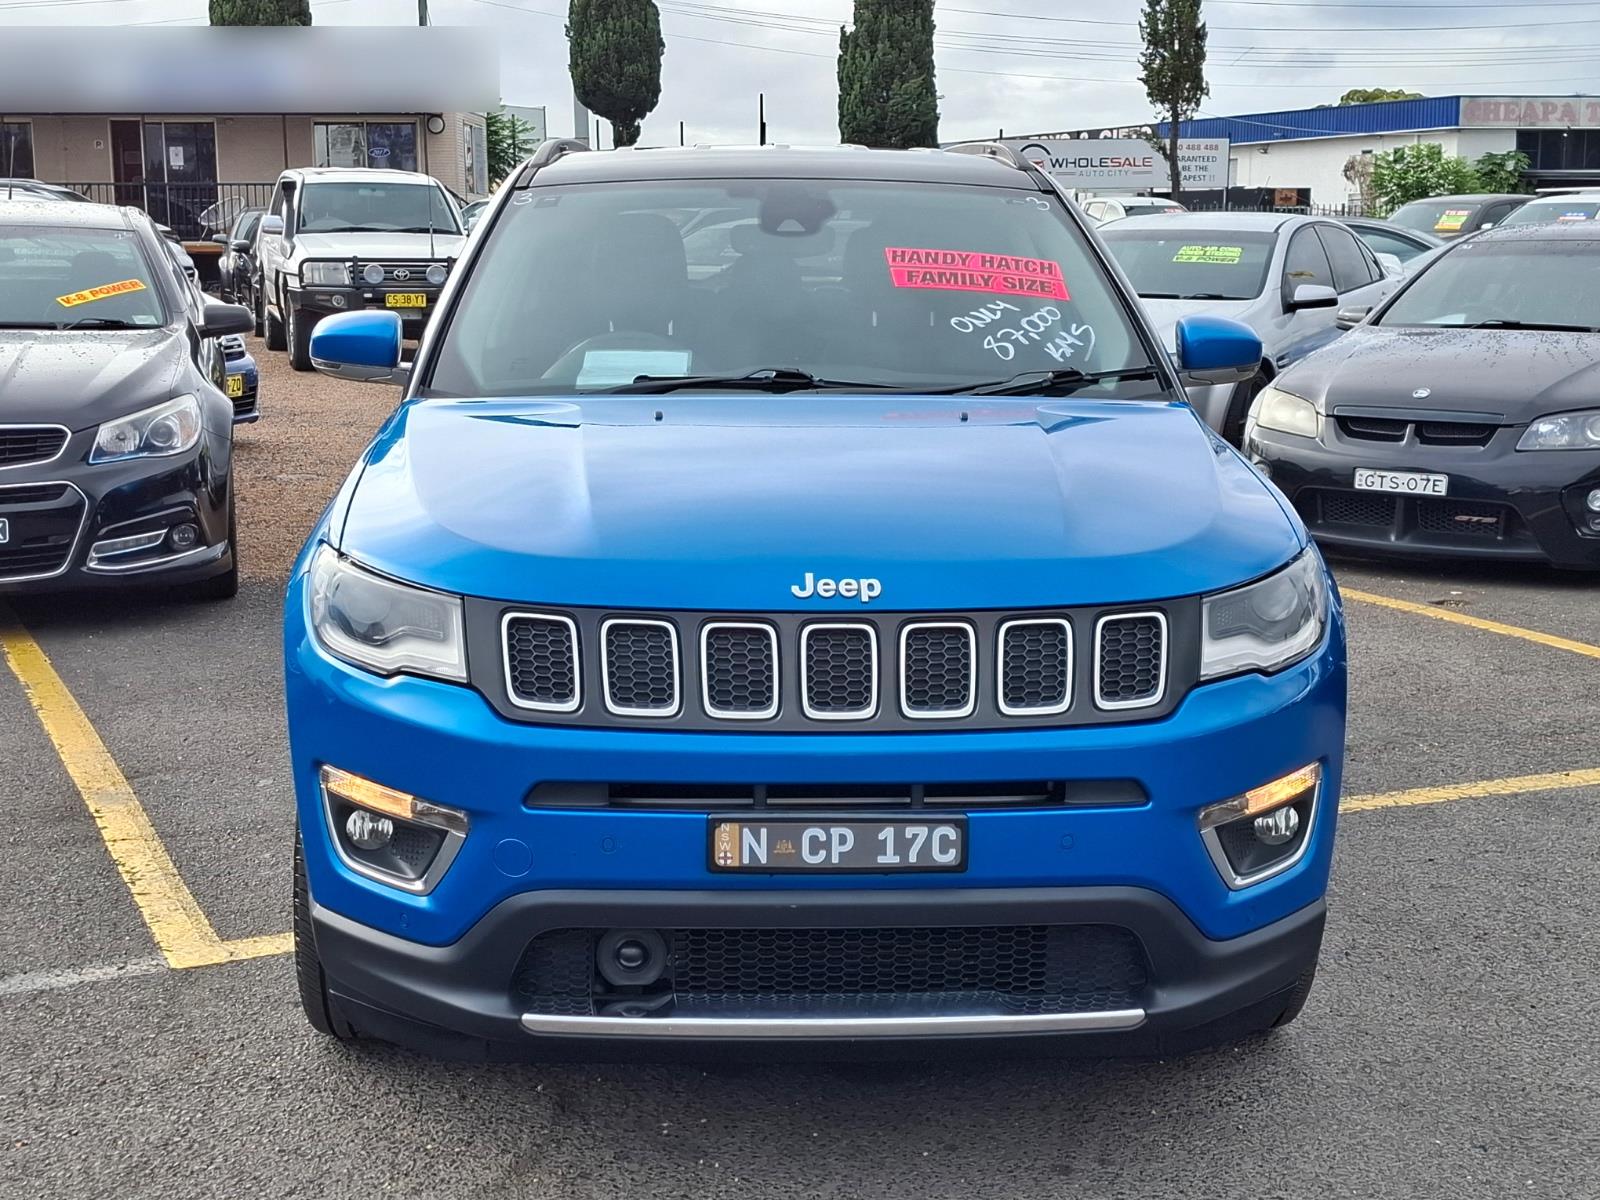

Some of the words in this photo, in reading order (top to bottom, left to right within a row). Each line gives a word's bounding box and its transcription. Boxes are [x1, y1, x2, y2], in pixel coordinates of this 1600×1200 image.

[1049, 157, 1153, 169] WHOLESALE
[1107, 169, 1130, 177] CITY
[891, 249, 971, 267] HANDY
[980, 255, 1054, 275] HATCH
[89, 280, 141, 297] POWER
[906, 270, 994, 287] FAMILY
[1002, 276, 1054, 294] SIZE
[950, 300, 1021, 333] ONLY
[983, 306, 1061, 361] 87,000
[791, 572, 882, 603] Jeep
[719, 823, 731, 851] NSW
[742, 827, 767, 864] N
[802, 827, 855, 864] CP
[877, 826, 958, 864] 17C
